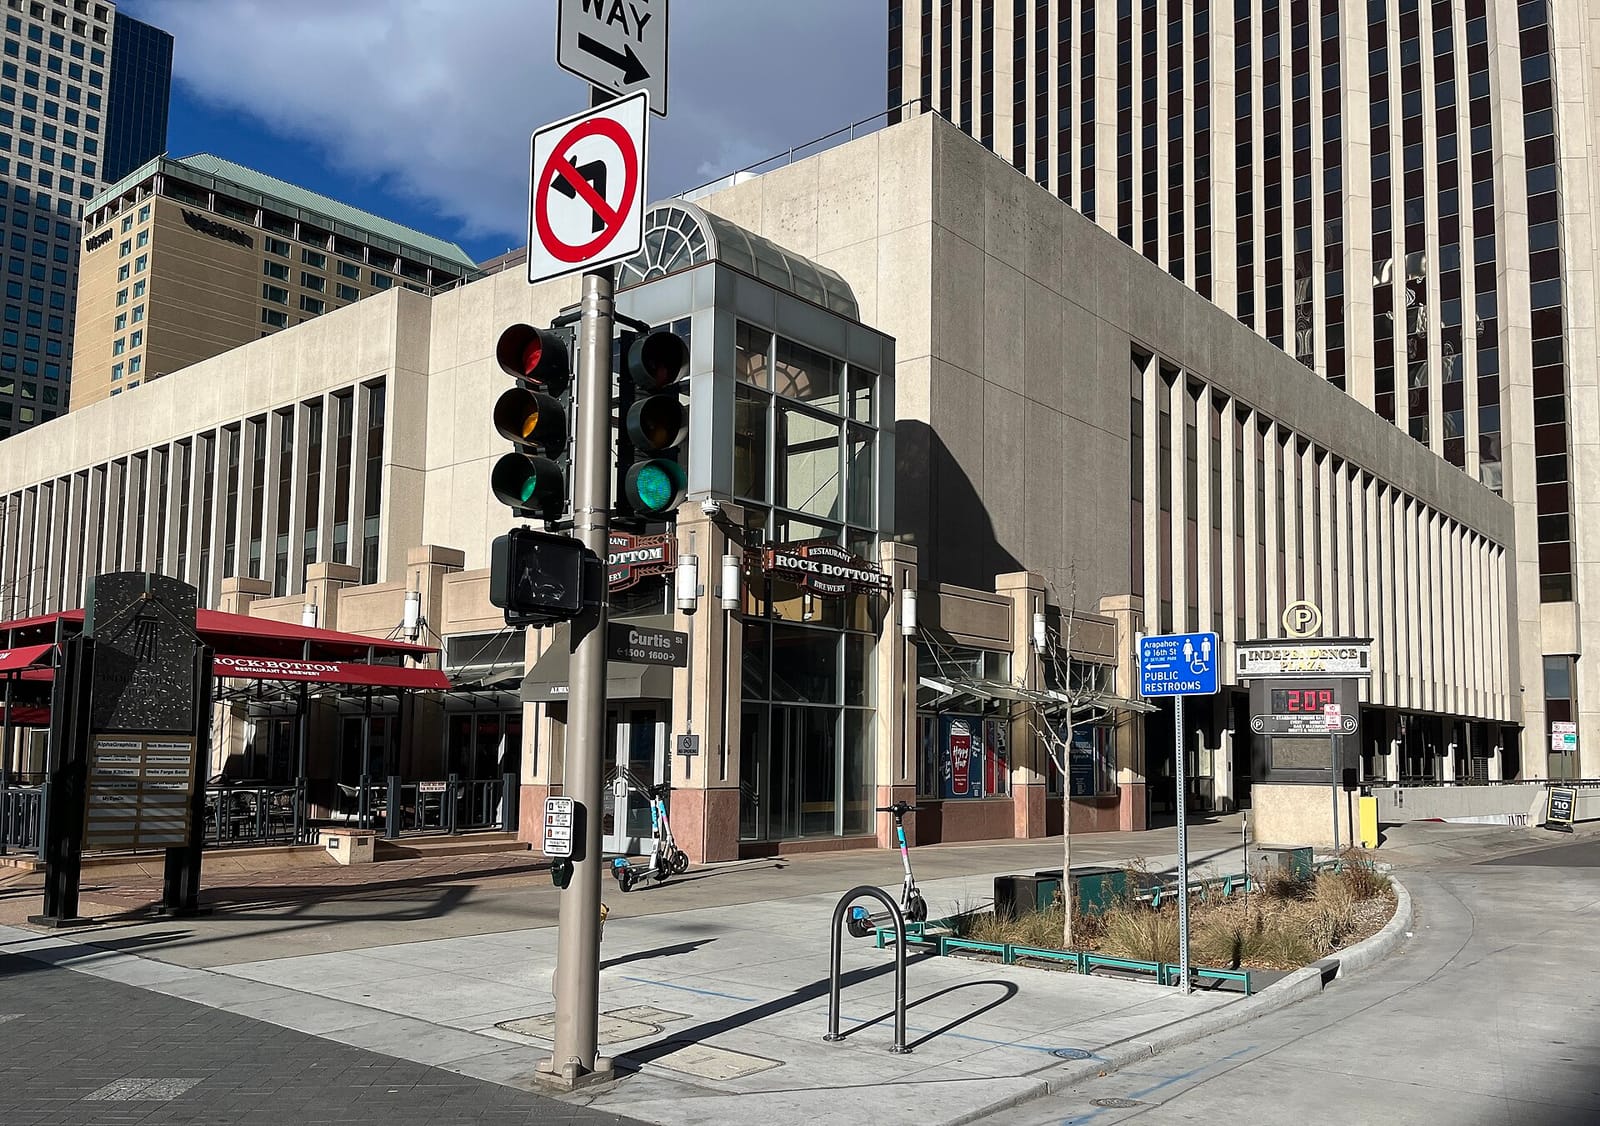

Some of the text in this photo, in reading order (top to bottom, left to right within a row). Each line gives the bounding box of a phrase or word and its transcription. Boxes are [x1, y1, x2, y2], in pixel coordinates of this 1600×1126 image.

[608, 547, 663, 565] OTTOM
[808, 547, 851, 562] RESTAURANT
[775, 554, 880, 583] ROCK BOTTOM
[813, 580, 845, 592] BREWERY
[629, 630, 671, 648] Curtis
[624, 648, 668, 660] 1500 1600
[1248, 648, 1357, 661] INDEPENDENCE
[234, 666, 280, 674] RESTAURANT
[1280, 661, 1326, 672] PLAZA
[1144, 671, 1178, 681] PUBLIC
[1145, 681, 1201, 692] RESTROOMS
